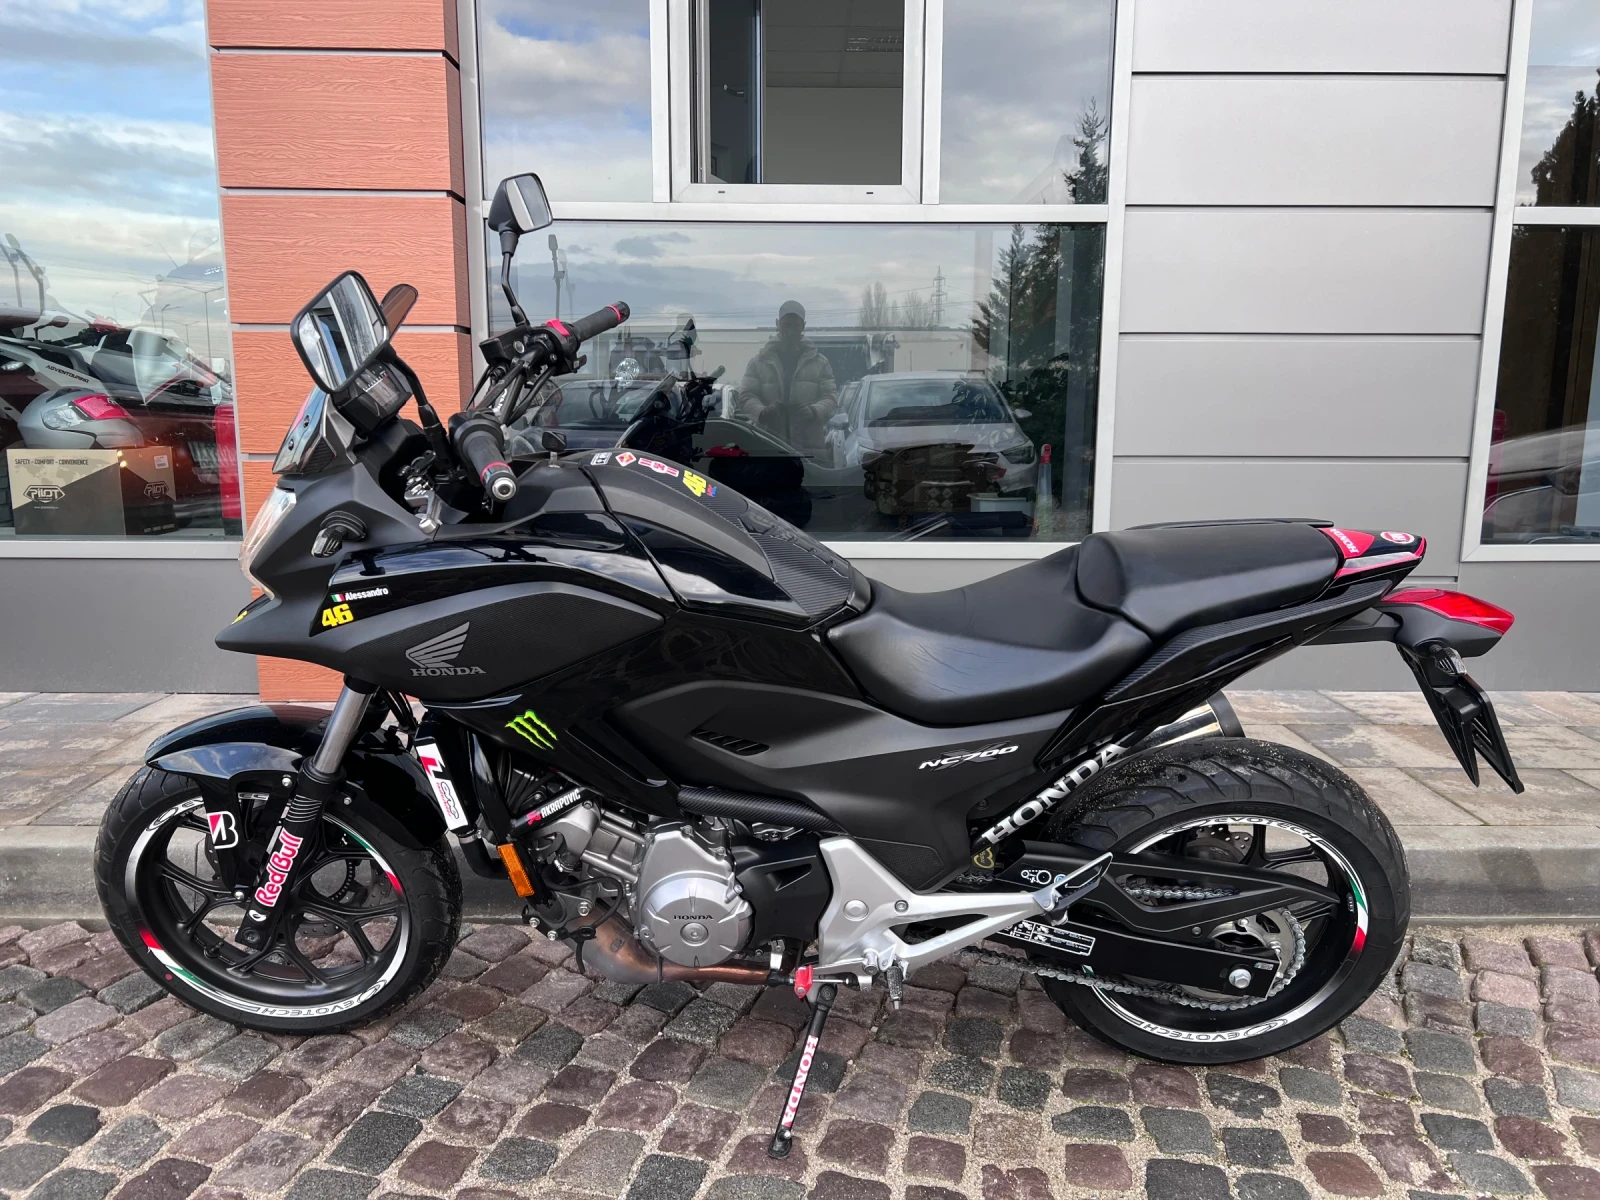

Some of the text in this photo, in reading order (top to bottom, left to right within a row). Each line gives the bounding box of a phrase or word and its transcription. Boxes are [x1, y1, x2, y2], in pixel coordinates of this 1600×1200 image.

[344, 587, 389, 602] Alessandro
[321, 603, 354, 628] 46
[410, 666, 486, 677] HONDA
[981, 743, 1131, 845] HONDA
[262, 999, 356, 1017] EVOTECH
[1144, 1022, 1241, 1041] EVOTECH
[782, 1035, 819, 1128] HONDA
